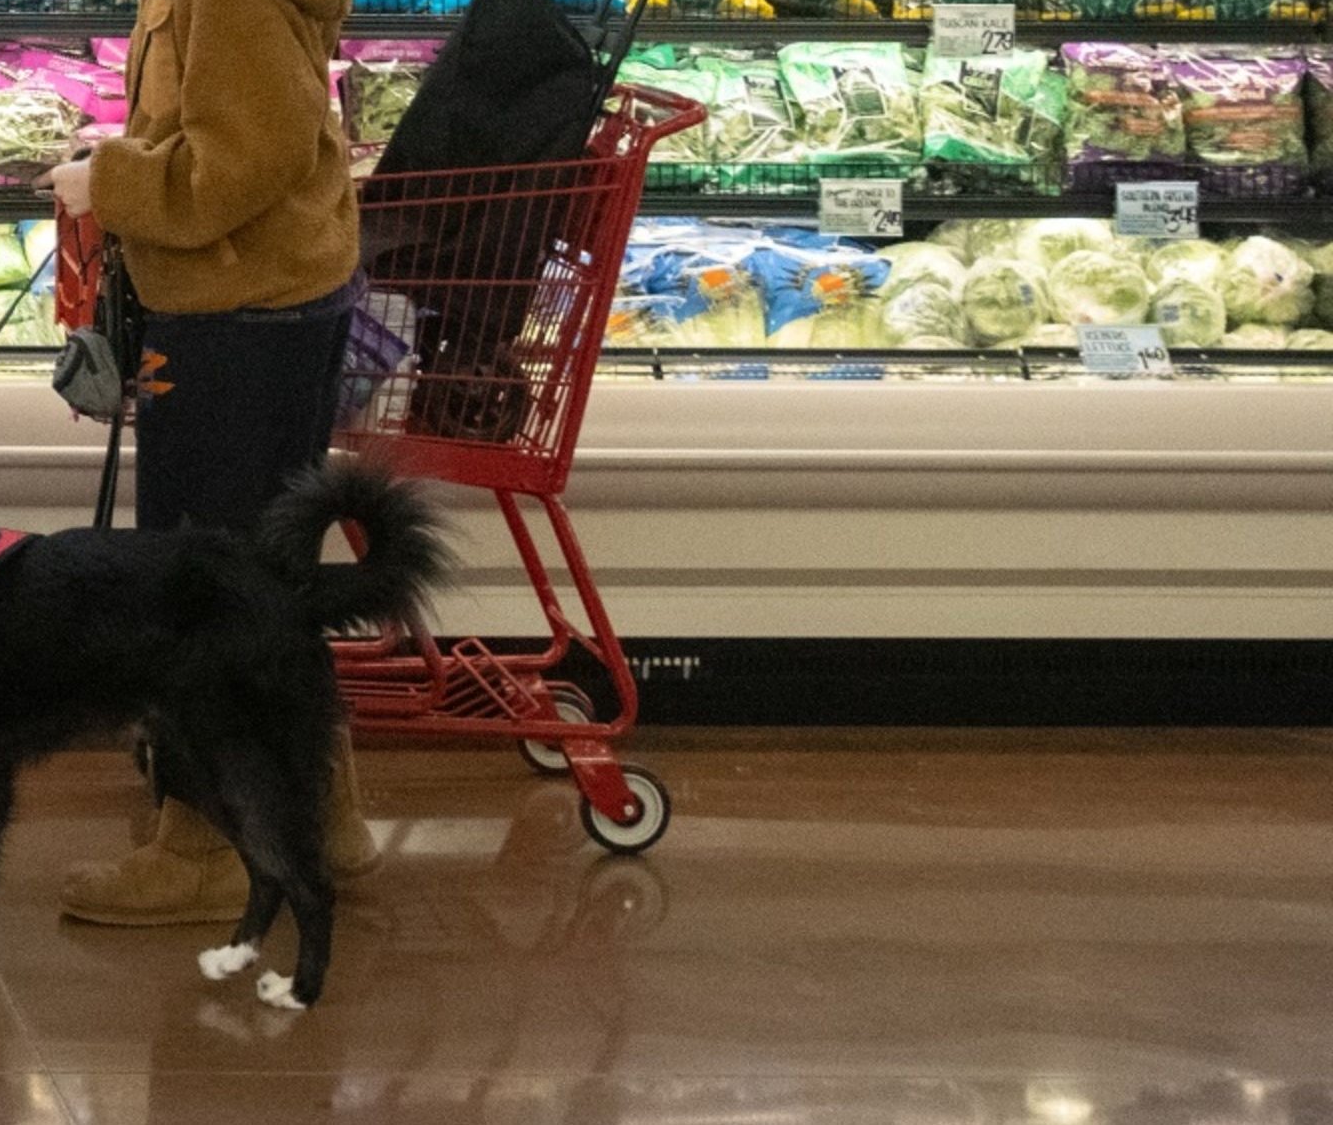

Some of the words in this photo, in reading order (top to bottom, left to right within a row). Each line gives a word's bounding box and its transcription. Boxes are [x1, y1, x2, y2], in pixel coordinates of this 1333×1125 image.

[940, 18, 979, 29] TUSCAN
[981, 18, 1008, 29] KALE
[1084, 341, 1131, 352] LETTUCE
